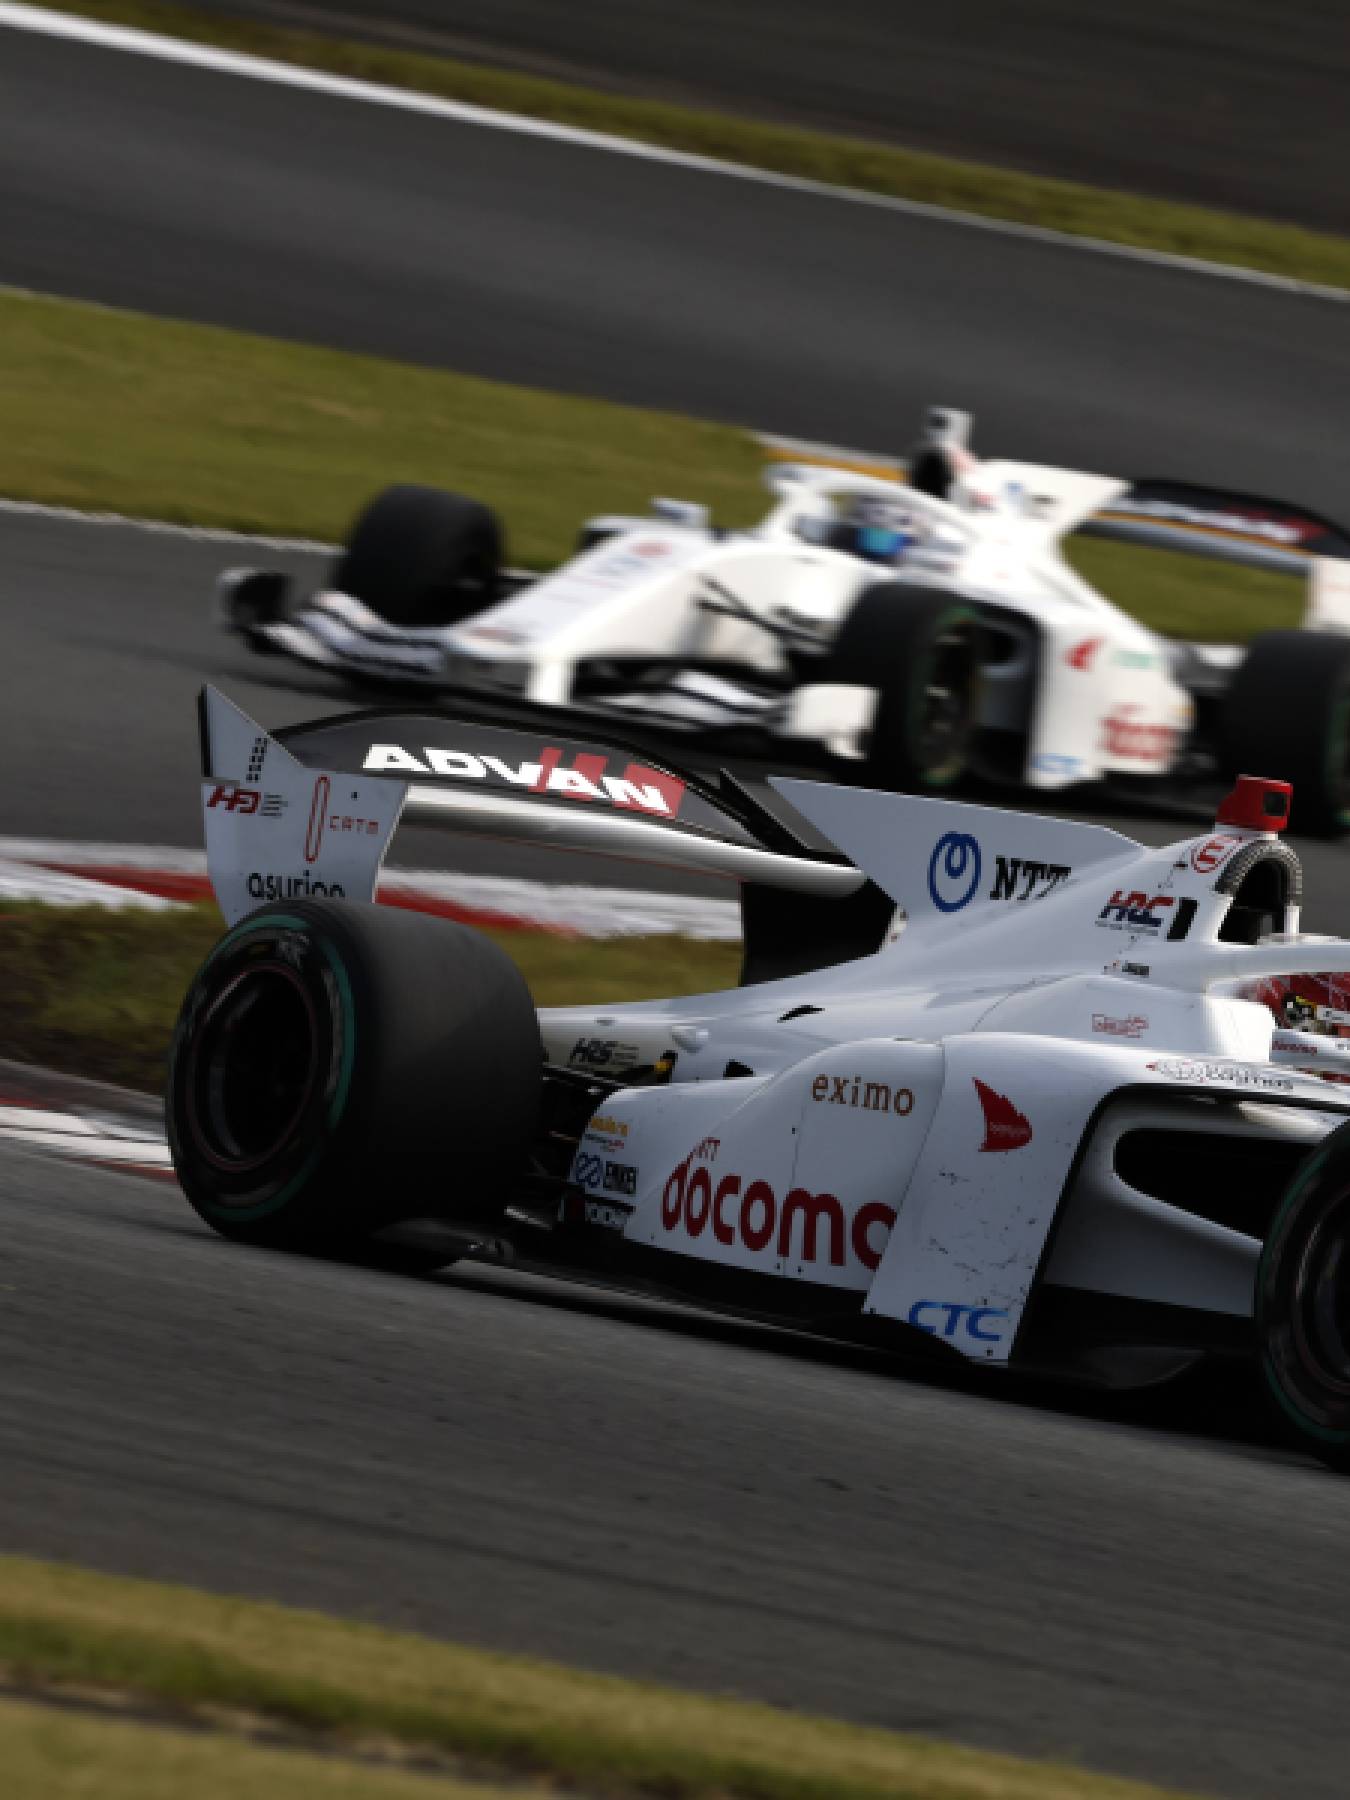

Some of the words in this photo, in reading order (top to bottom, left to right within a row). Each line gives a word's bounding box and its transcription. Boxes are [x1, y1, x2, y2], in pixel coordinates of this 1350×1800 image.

[362, 743, 672, 814] ADVAN
[989, 856, 1072, 900] NTT
[811, 1074, 915, 1116] eximo
[661, 1154, 898, 1271] docomo
[908, 1301, 1009, 1342] CTC
